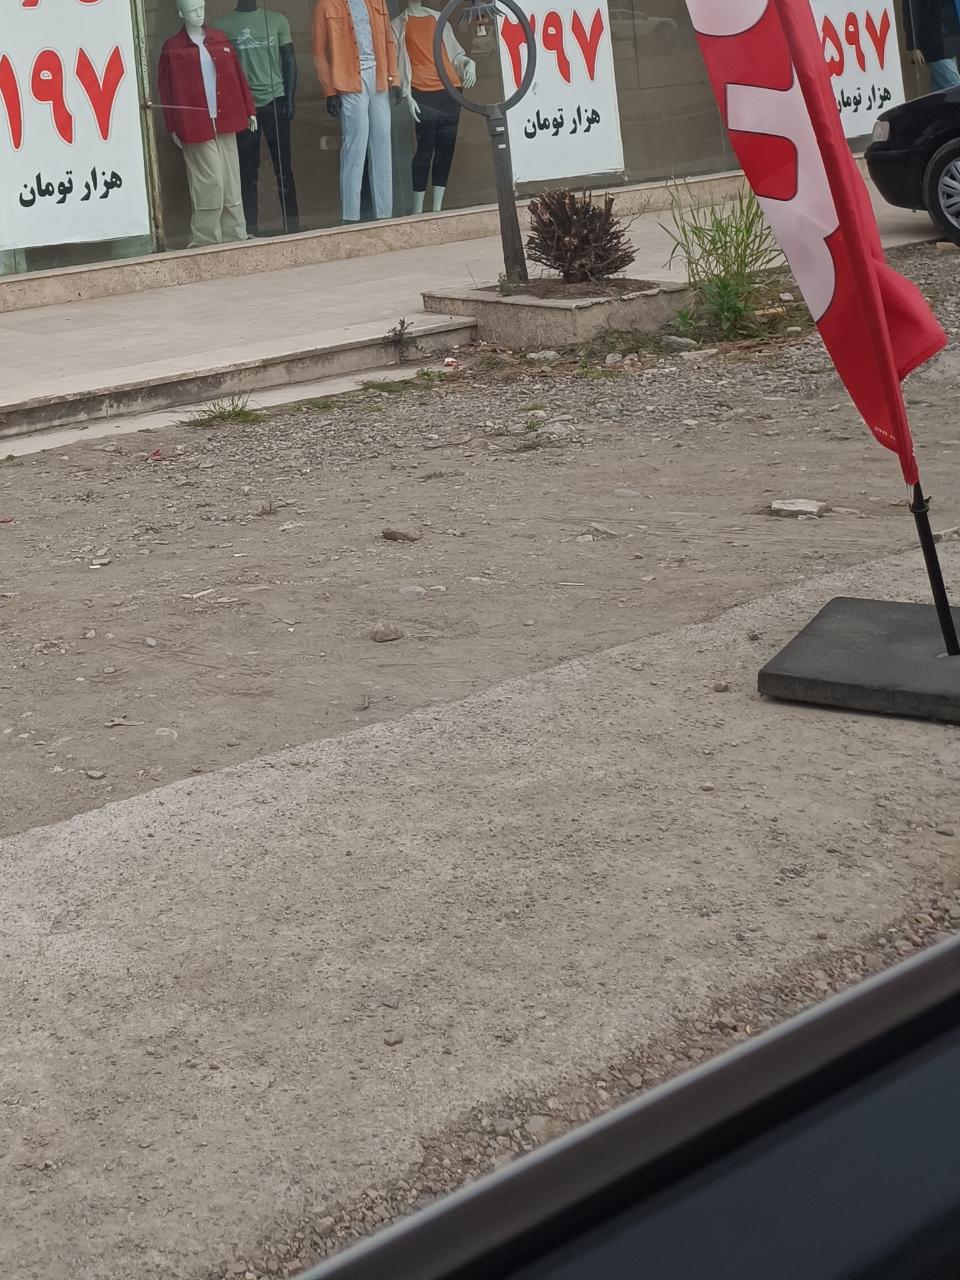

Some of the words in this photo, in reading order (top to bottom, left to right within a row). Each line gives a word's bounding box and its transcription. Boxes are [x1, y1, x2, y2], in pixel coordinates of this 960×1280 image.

[822, 8, 891, 78] ۵۹۷
[836, 87, 863, 114] توما
[866, 84, 892, 111] هزار
[524, 107, 565, 139] تومان
[569, 105, 602, 135] هزار
[19, 170, 74, 208] تومان
[80, 166, 123, 202] هزار
